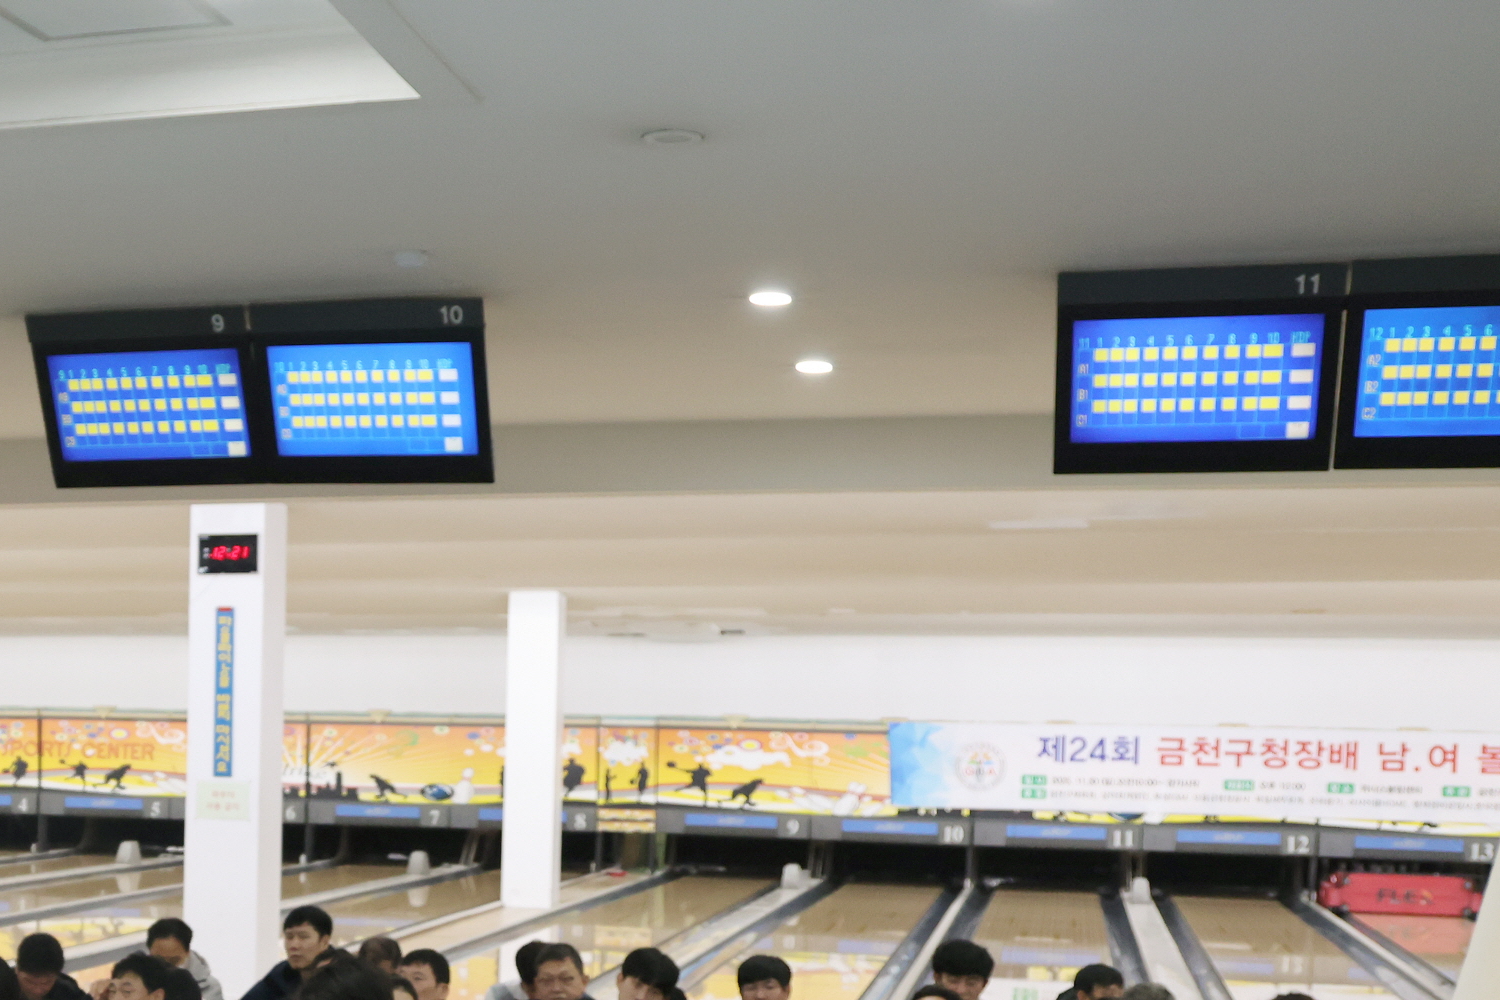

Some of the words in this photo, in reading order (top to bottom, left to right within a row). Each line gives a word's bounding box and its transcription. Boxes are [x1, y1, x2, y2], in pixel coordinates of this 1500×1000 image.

[1295, 274, 1320, 294] 11
[211, 314, 225, 332] 9
[440, 305, 463, 325] 10
[85, 741, 155, 761] CENTER
[1037, 735, 1140, 765] 제24회
[1157, 736, 1358, 771] 금천구청장배
[1378, 741, 1459, 774] 남.여
[18, 797, 28, 812] 4
[151, 801, 161, 816] 5
[285, 805, 296, 820] 6
[429, 809, 440, 826] 7
[573, 812, 586, 830] 8
[786, 818, 799, 836] 9
[943, 825, 965, 843] 10
[1112, 829, 1134, 848] 11
[1286, 835, 1310, 855] 12
[1471, 842, 1495, 862] 13
